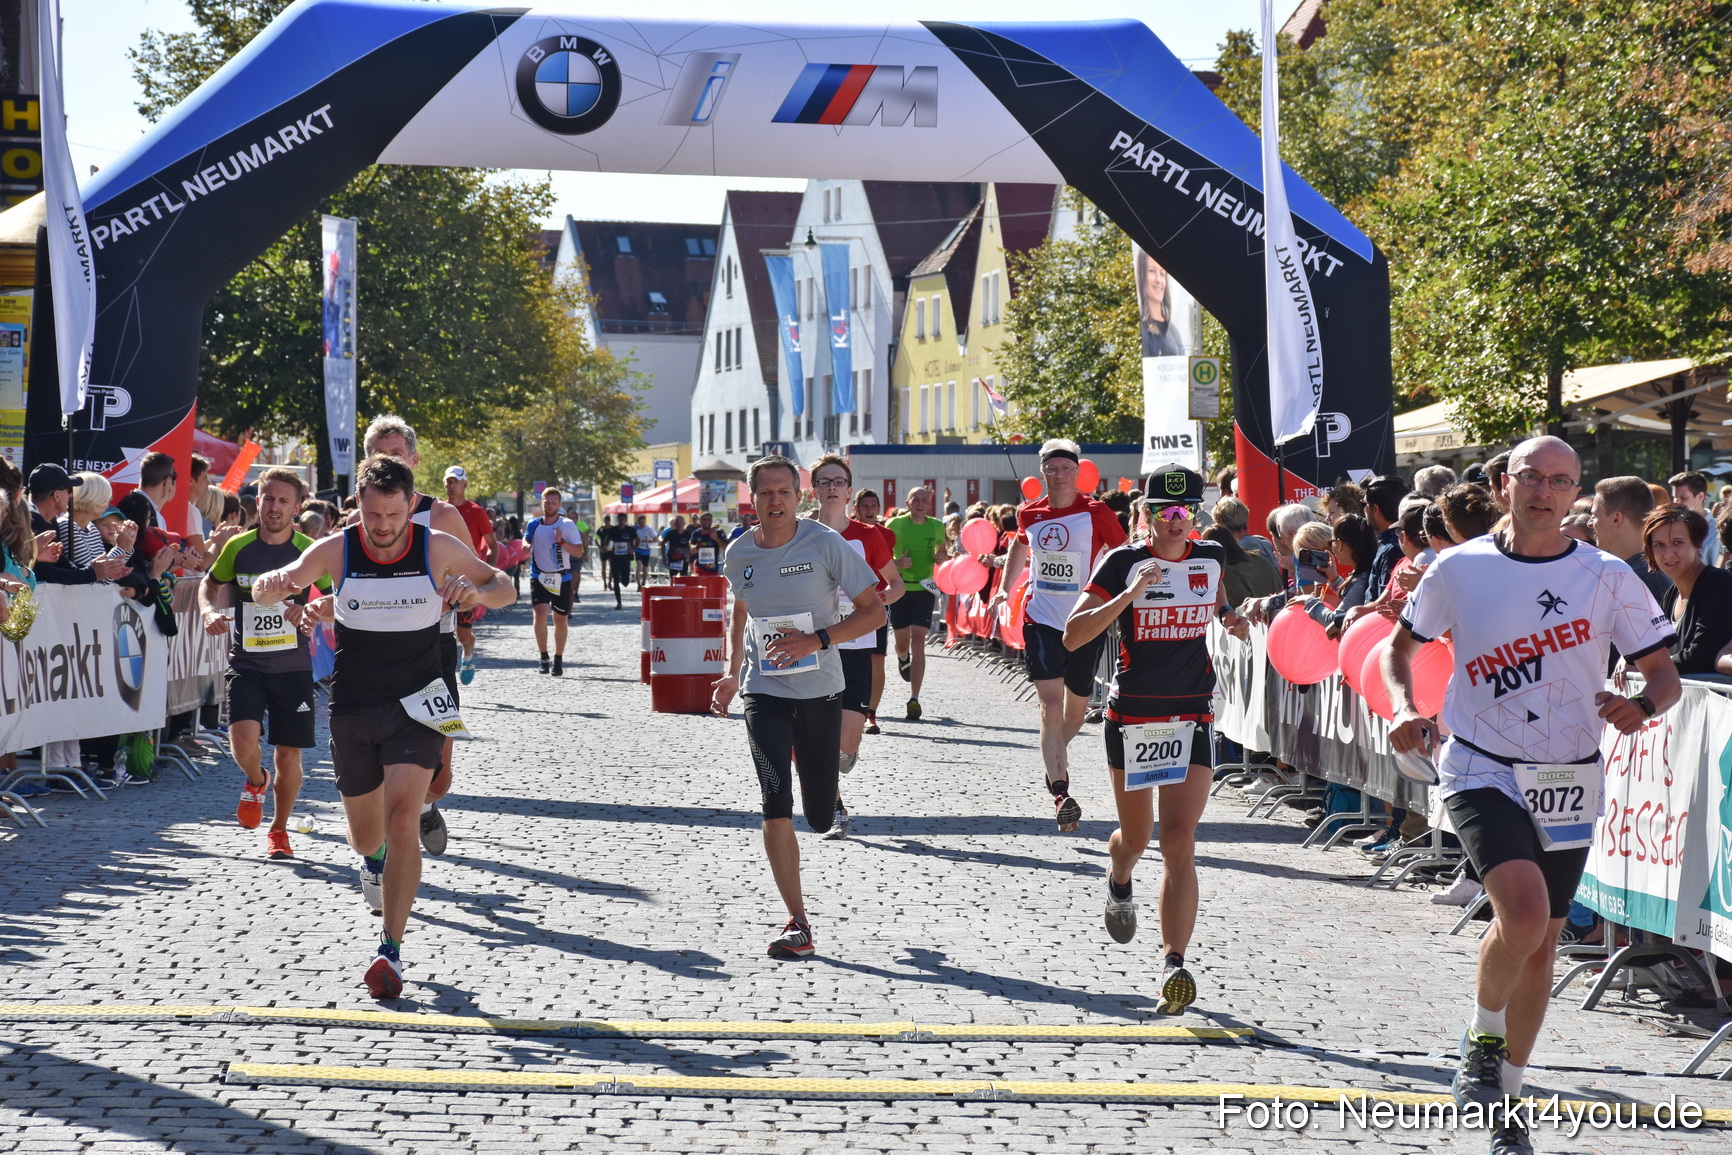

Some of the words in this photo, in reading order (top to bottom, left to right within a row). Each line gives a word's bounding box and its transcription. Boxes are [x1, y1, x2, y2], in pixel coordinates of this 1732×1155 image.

[526, 36, 612, 68] BMW
[90, 191, 185, 250] PARTL
[181, 103, 335, 202] NEUMARKT
[1109, 130, 1192, 196] PARTL
[1195, 181, 1344, 278] NEUMRKT
[1274, 244, 1318, 352] NEUMARKT
[86, 461, 115, 471] NEXT
[1294, 488, 1314, 498] THE
[780, 563, 812, 574] BOCK
[1041, 562, 1073, 577] 2603
[543, 578, 556, 586] 274
[254, 615, 283, 631] 289
[769, 621, 795, 629] BOCK
[255, 638, 285, 646] Johannes
[1465, 618, 1591, 687] FINISHER
[1486, 655, 1542, 699] 2017
[422, 695, 456, 717] 194
[1136, 740, 1182, 762] 2200
[1144, 771, 1168, 782] Annika
[1538, 771, 1575, 781] BOCK
[1525, 786, 1584, 814] 3072
[1602, 797, 1688, 870] BESSER
[1696, 918, 1713, 940] Jura
